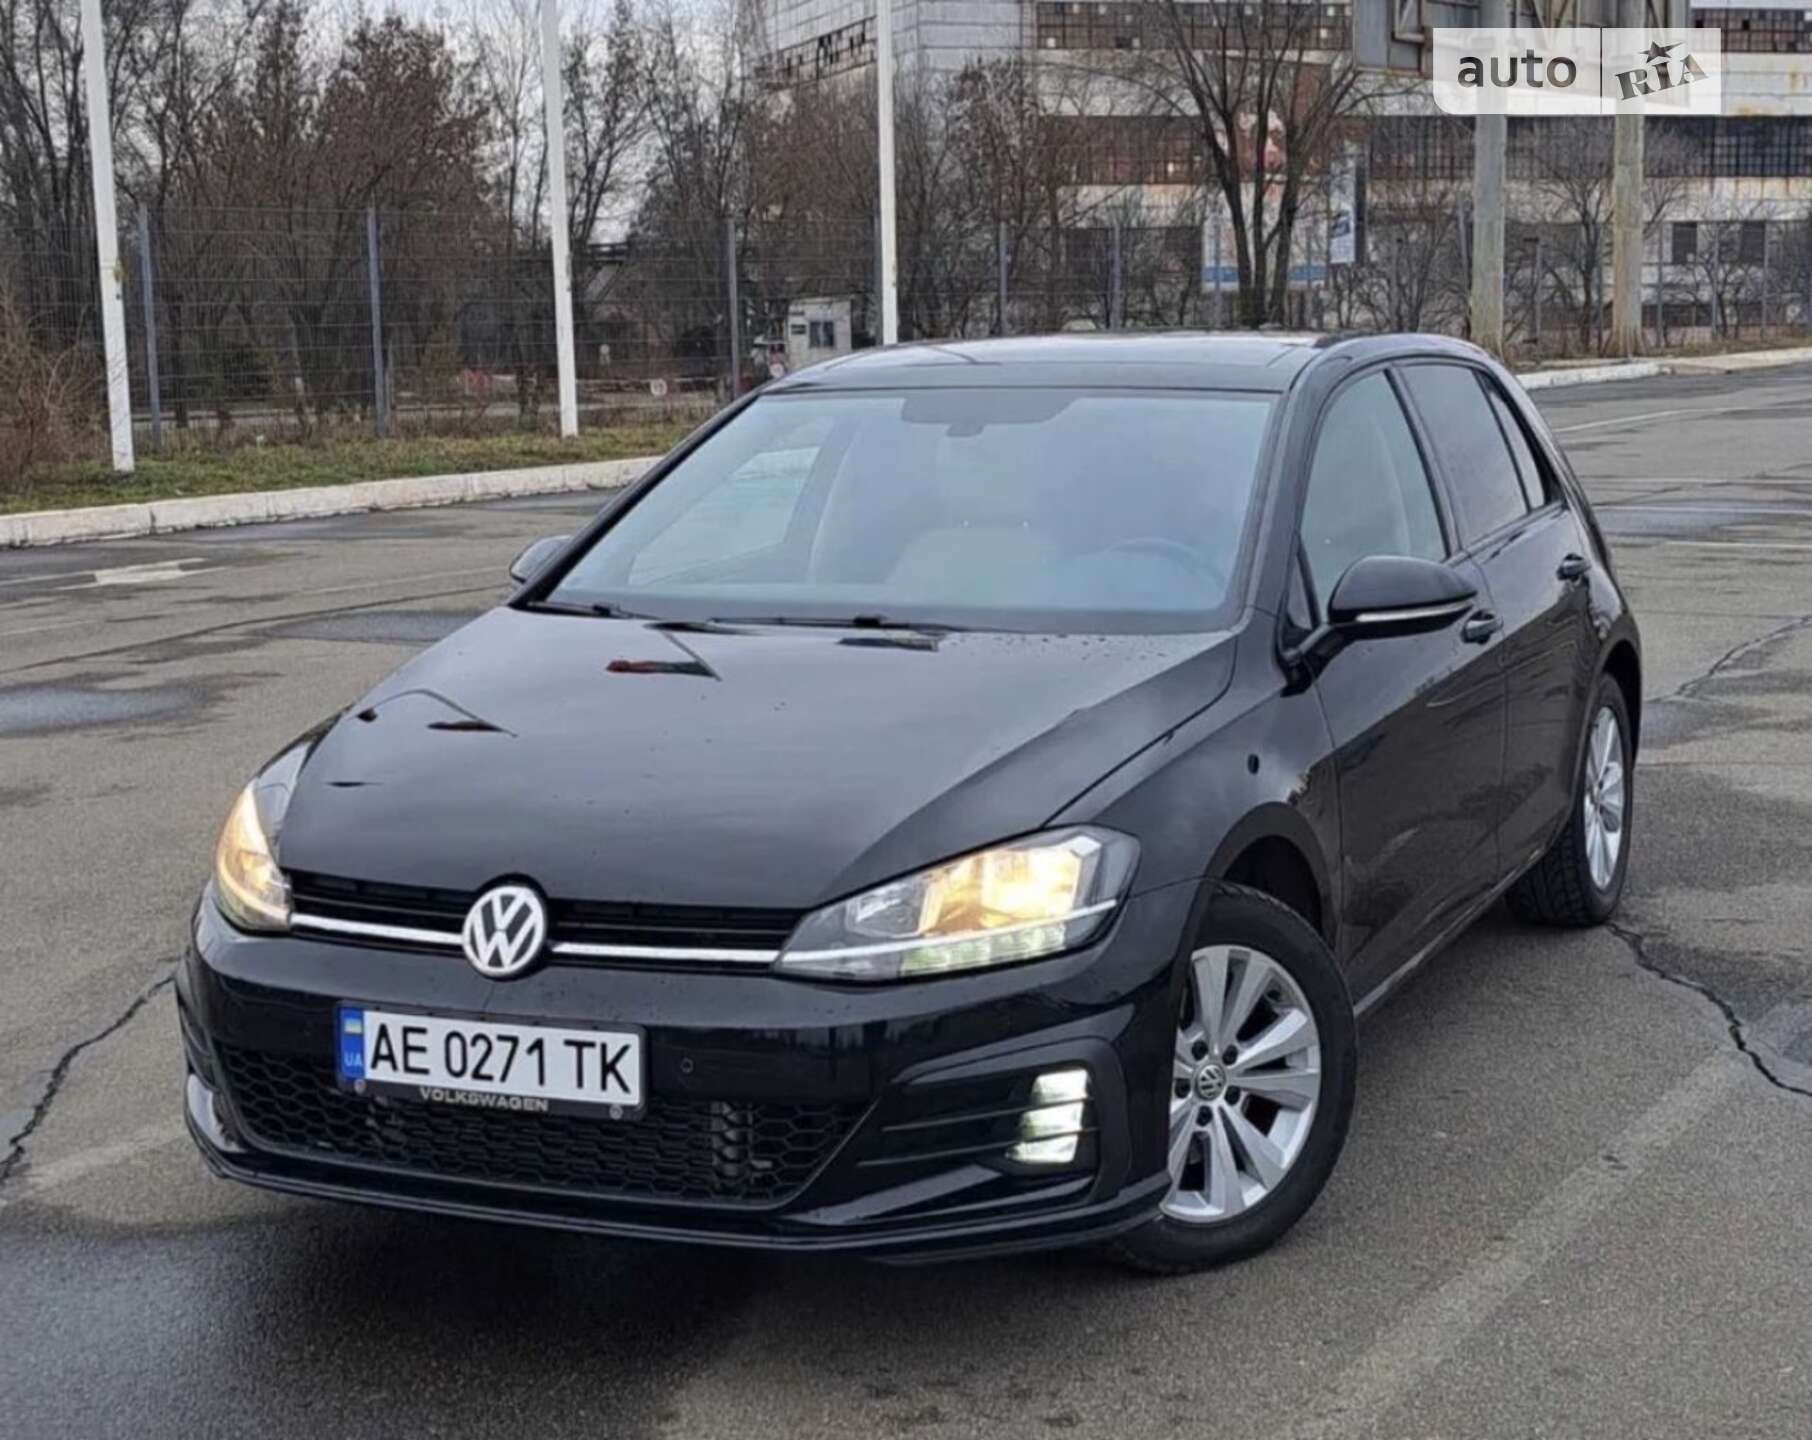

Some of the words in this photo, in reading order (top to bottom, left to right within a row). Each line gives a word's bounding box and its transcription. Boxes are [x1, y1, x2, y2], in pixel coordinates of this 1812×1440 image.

[343, 1052, 363, 1067] UA
[370, 1022, 430, 1075] AE
[444, 1031, 545, 1086] 0271
[563, 1039, 632, 1094] TK
[420, 1086, 548, 1112] VOLKSWAGEN
